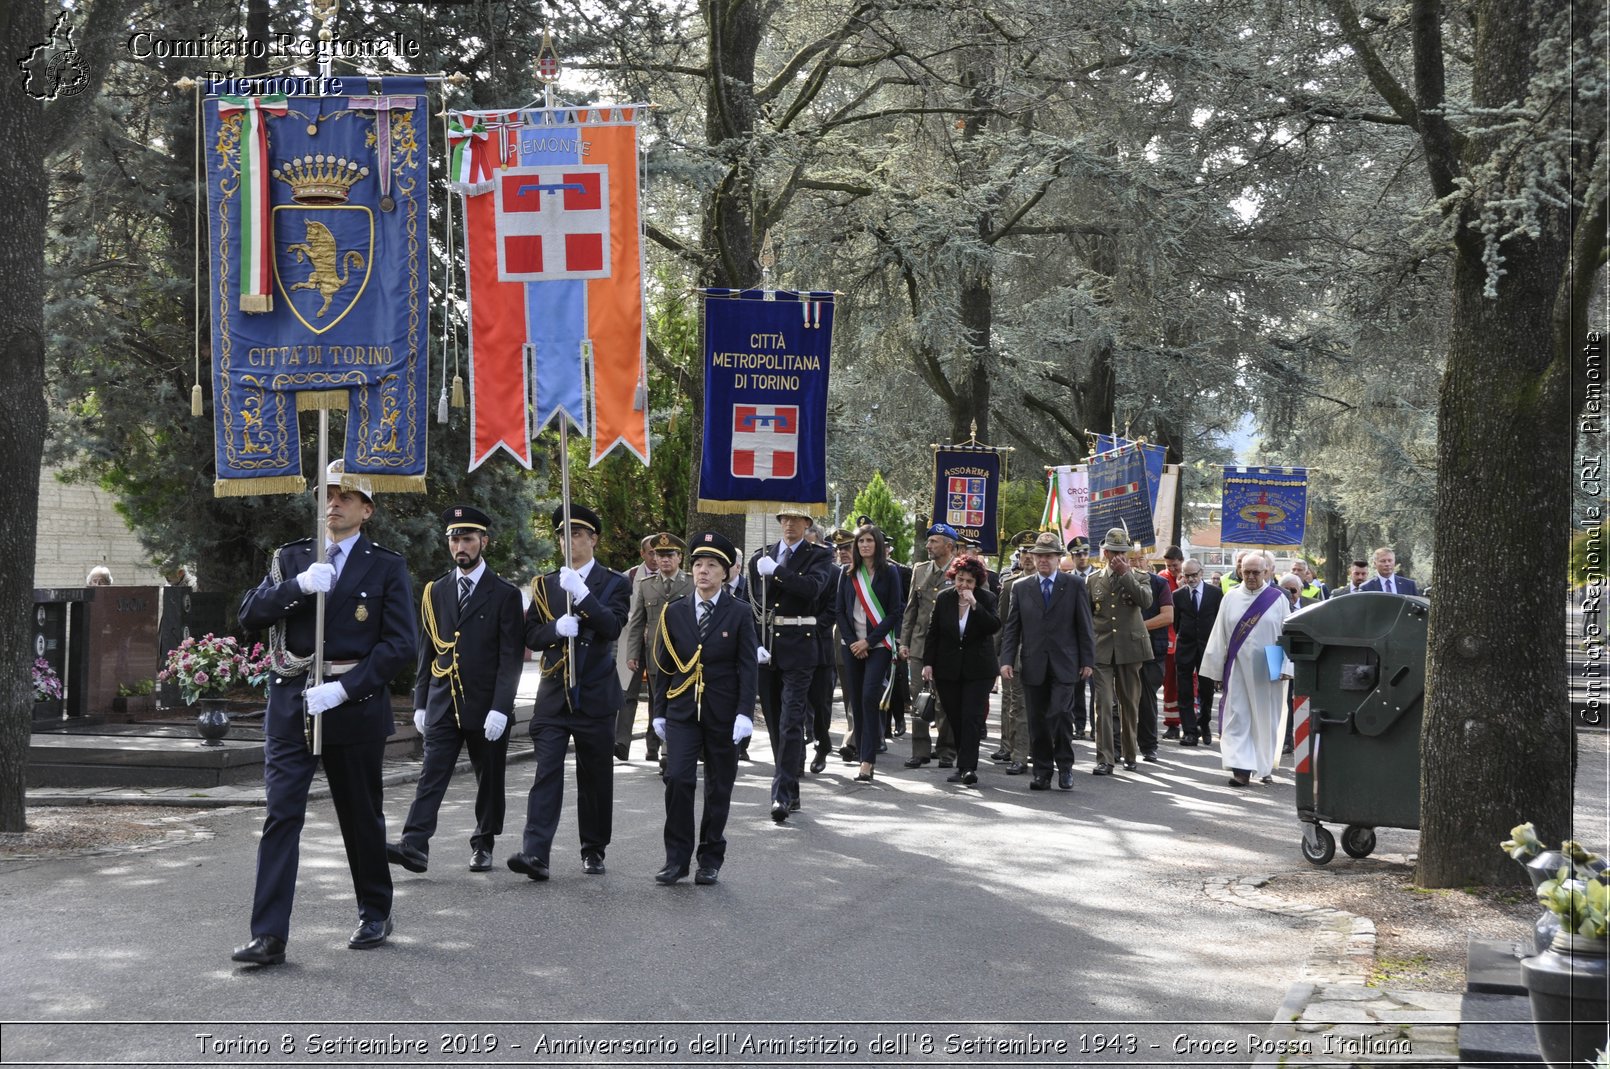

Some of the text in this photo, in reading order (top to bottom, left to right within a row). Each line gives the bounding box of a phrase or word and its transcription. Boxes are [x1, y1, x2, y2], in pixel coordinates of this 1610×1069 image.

[750, 331, 786, 349] CITTÀ
[308, 345, 322, 364] DI
[328, 345, 393, 365] TORINO
[713, 352, 821, 371] METROPOLITANA
[734, 373, 800, 391] DI TORINO
[944, 466, 990, 479] ASSOARMA
[1067, 487, 1088, 495] CROC
[1077, 496, 1088, 504] ITA
[955, 528, 980, 538] ORINO
